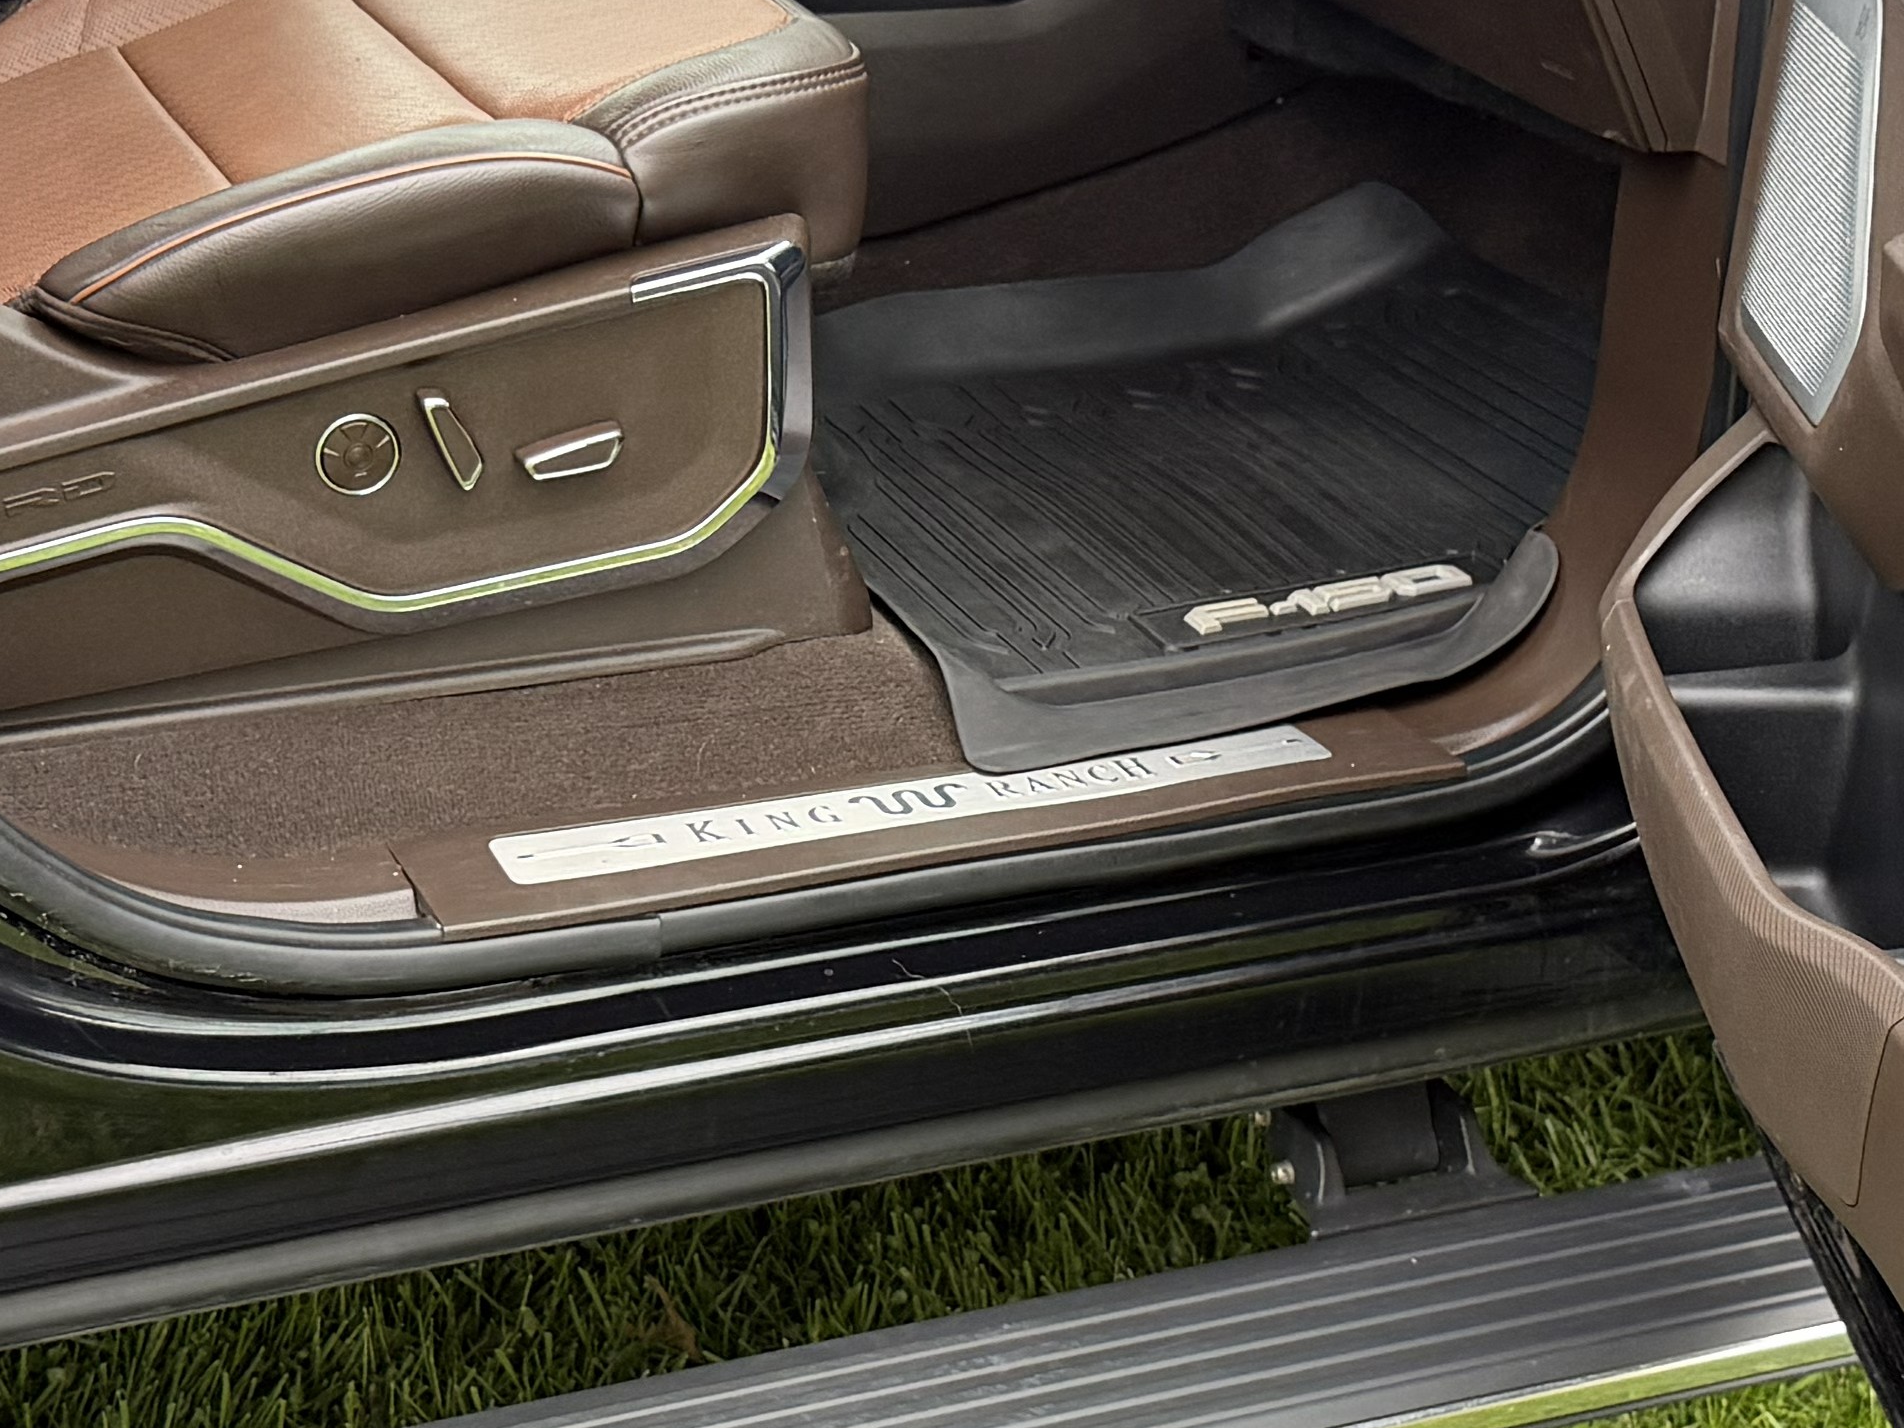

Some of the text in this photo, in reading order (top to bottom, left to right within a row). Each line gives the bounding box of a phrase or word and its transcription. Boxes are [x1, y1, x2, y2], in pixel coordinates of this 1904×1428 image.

[1183, 564, 1474, 636] F-150
[685, 756, 1157, 844] KING RANCH
